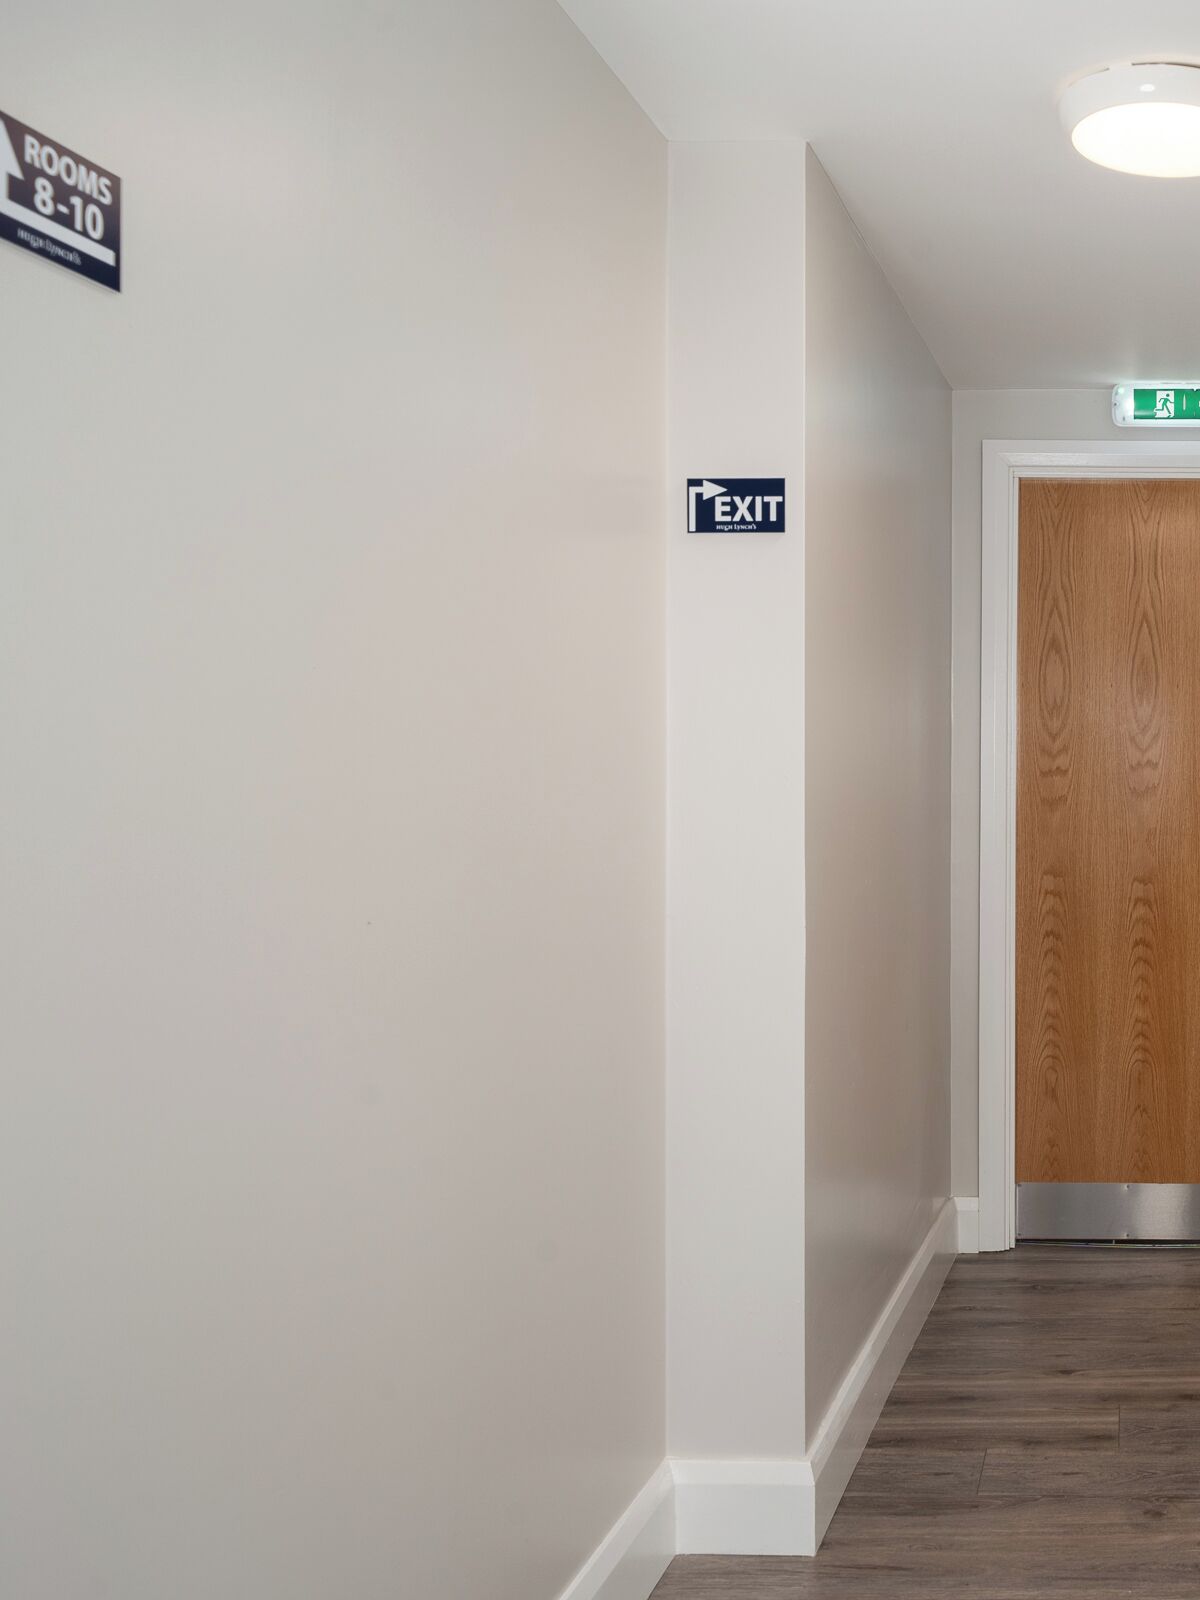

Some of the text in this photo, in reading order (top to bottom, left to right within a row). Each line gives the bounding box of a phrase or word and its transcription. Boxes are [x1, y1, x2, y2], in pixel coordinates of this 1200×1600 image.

[24, 133, 113, 206] ROOMS
[33, 176, 105, 241] 8-10
[714, 495, 784, 522] EXIT
